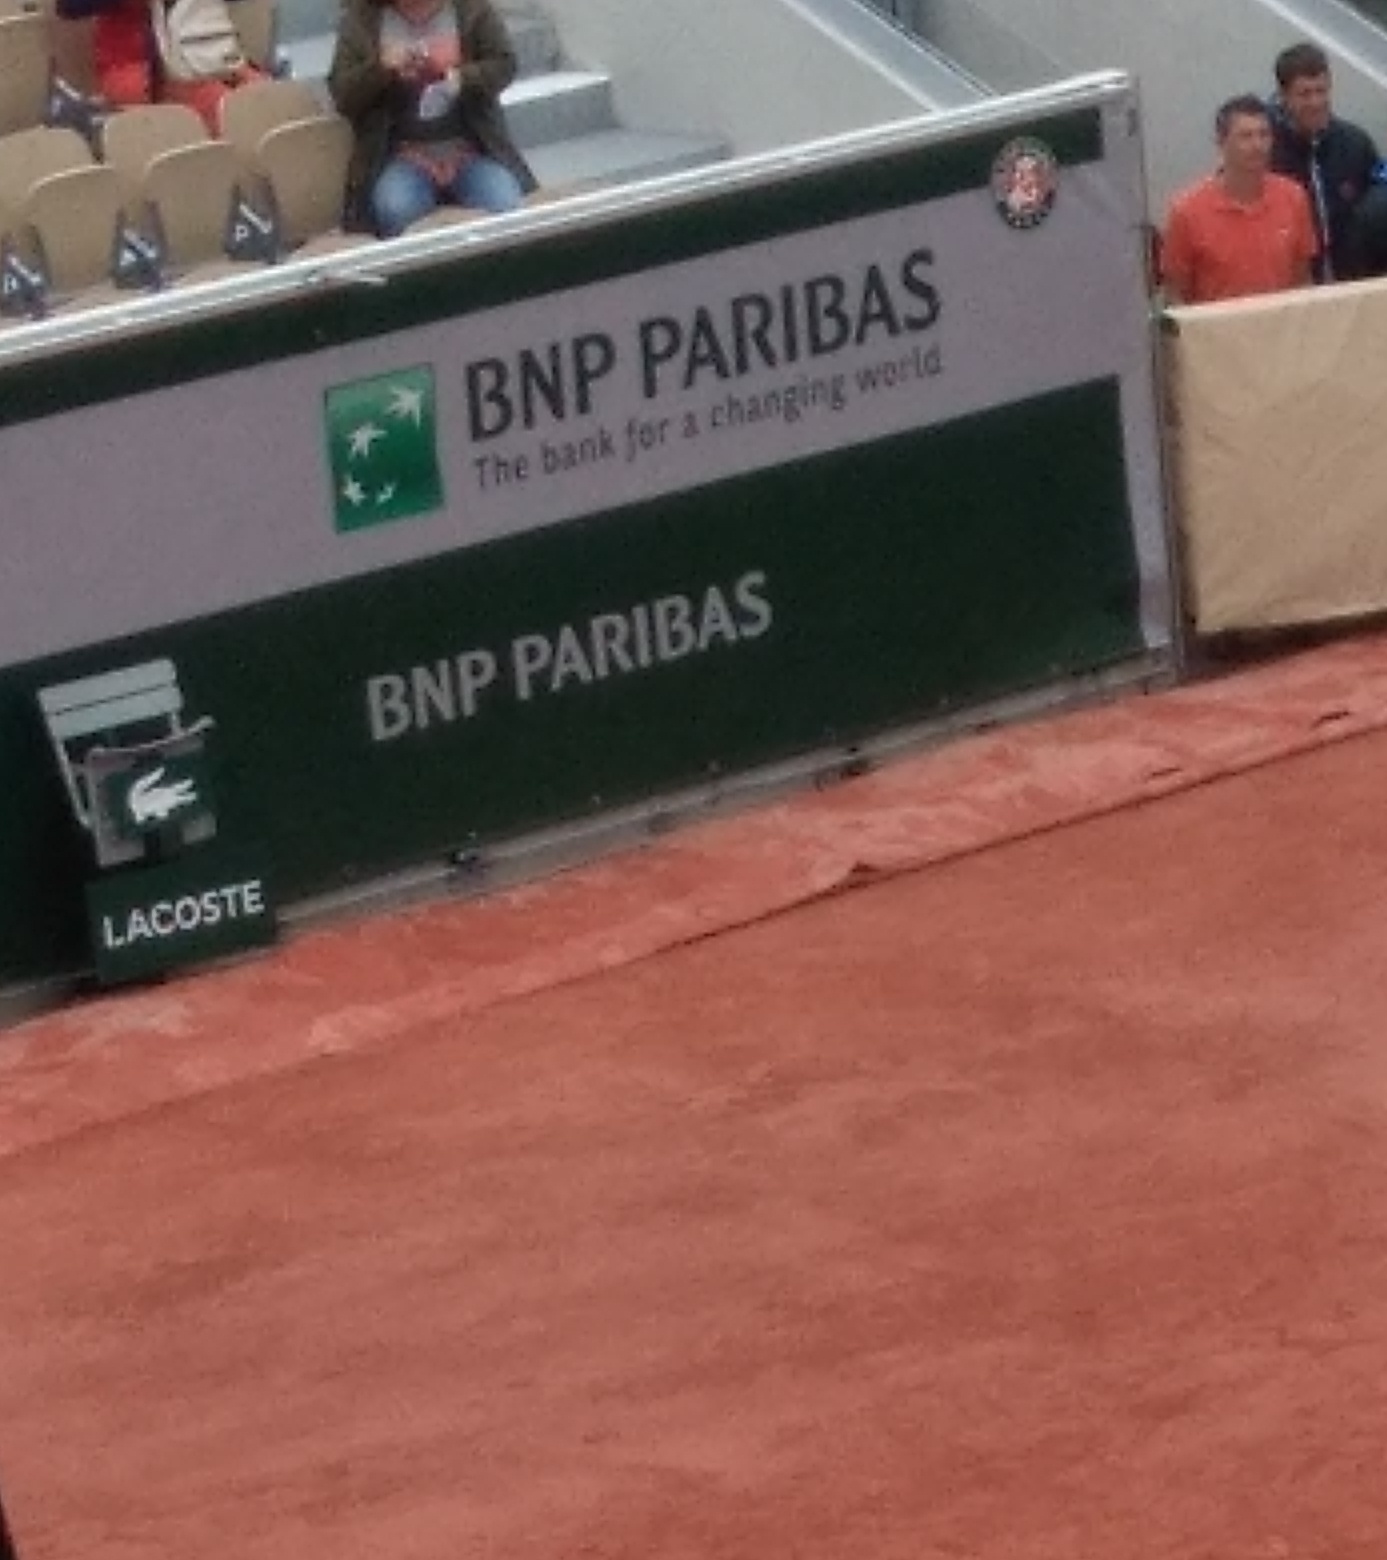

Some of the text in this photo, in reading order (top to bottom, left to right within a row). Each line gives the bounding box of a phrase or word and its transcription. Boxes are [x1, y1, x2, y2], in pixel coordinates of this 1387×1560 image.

[465, 248, 942, 443] BNP PARIBAS
[472, 344, 943, 489] The bank for a changing world
[366, 570, 774, 741] BNP PARIBAS
[103, 879, 265, 949] LACOSTE
